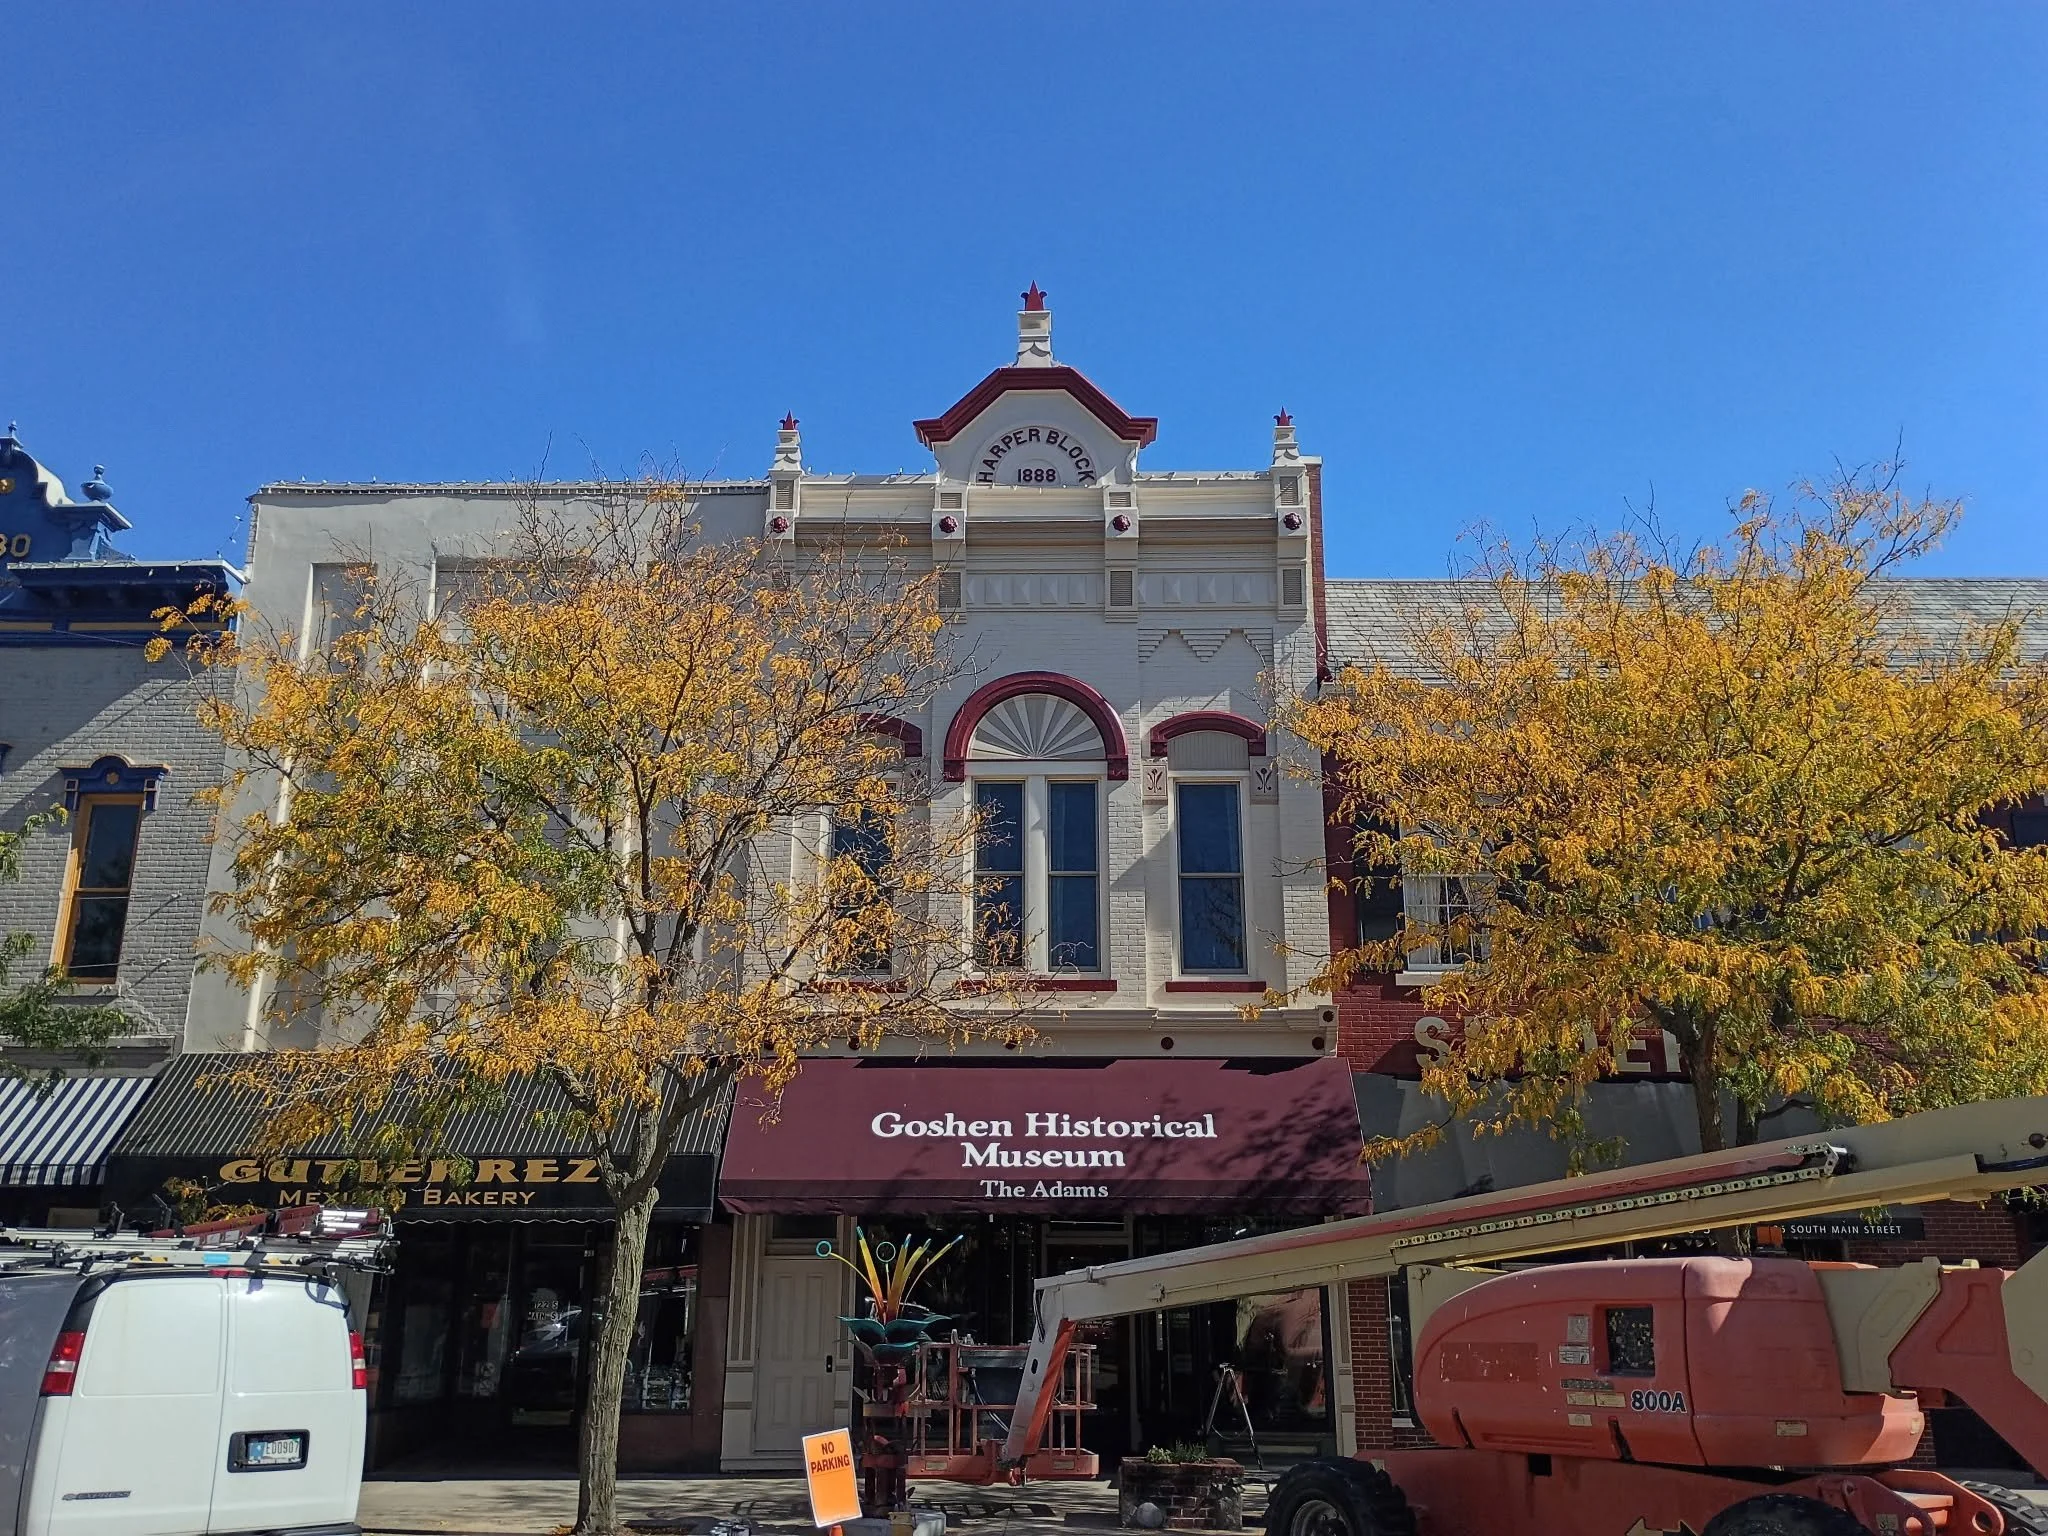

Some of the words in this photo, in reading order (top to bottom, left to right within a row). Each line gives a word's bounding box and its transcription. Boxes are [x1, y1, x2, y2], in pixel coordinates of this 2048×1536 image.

[978, 428, 1041, 483] HARPER
[1046, 429, 1095, 483] BLOCK
[1017, 468, 1056, 483] 1888
[871, 1112, 1013, 1138] Goshen
[1025, 1112, 1217, 1138] Historical
[961, 1142, 1126, 1167] Museum
[279, 1189, 406, 1206] MEXI
[423, 1189, 536, 1205] BAKERY
[980, 1180, 1025, 1198] The
[1031, 1180, 1109, 1198] Adams
[1790, 1225, 1826, 1234] SOUTH
[1832, 1225, 1859, 1235] MAIN
[1864, 1225, 1901, 1234] STREET
[1631, 1389, 1687, 1414] 800A
[821, 1441, 835, 1455] NO
[810, 1454, 851, 1474] PARKING
